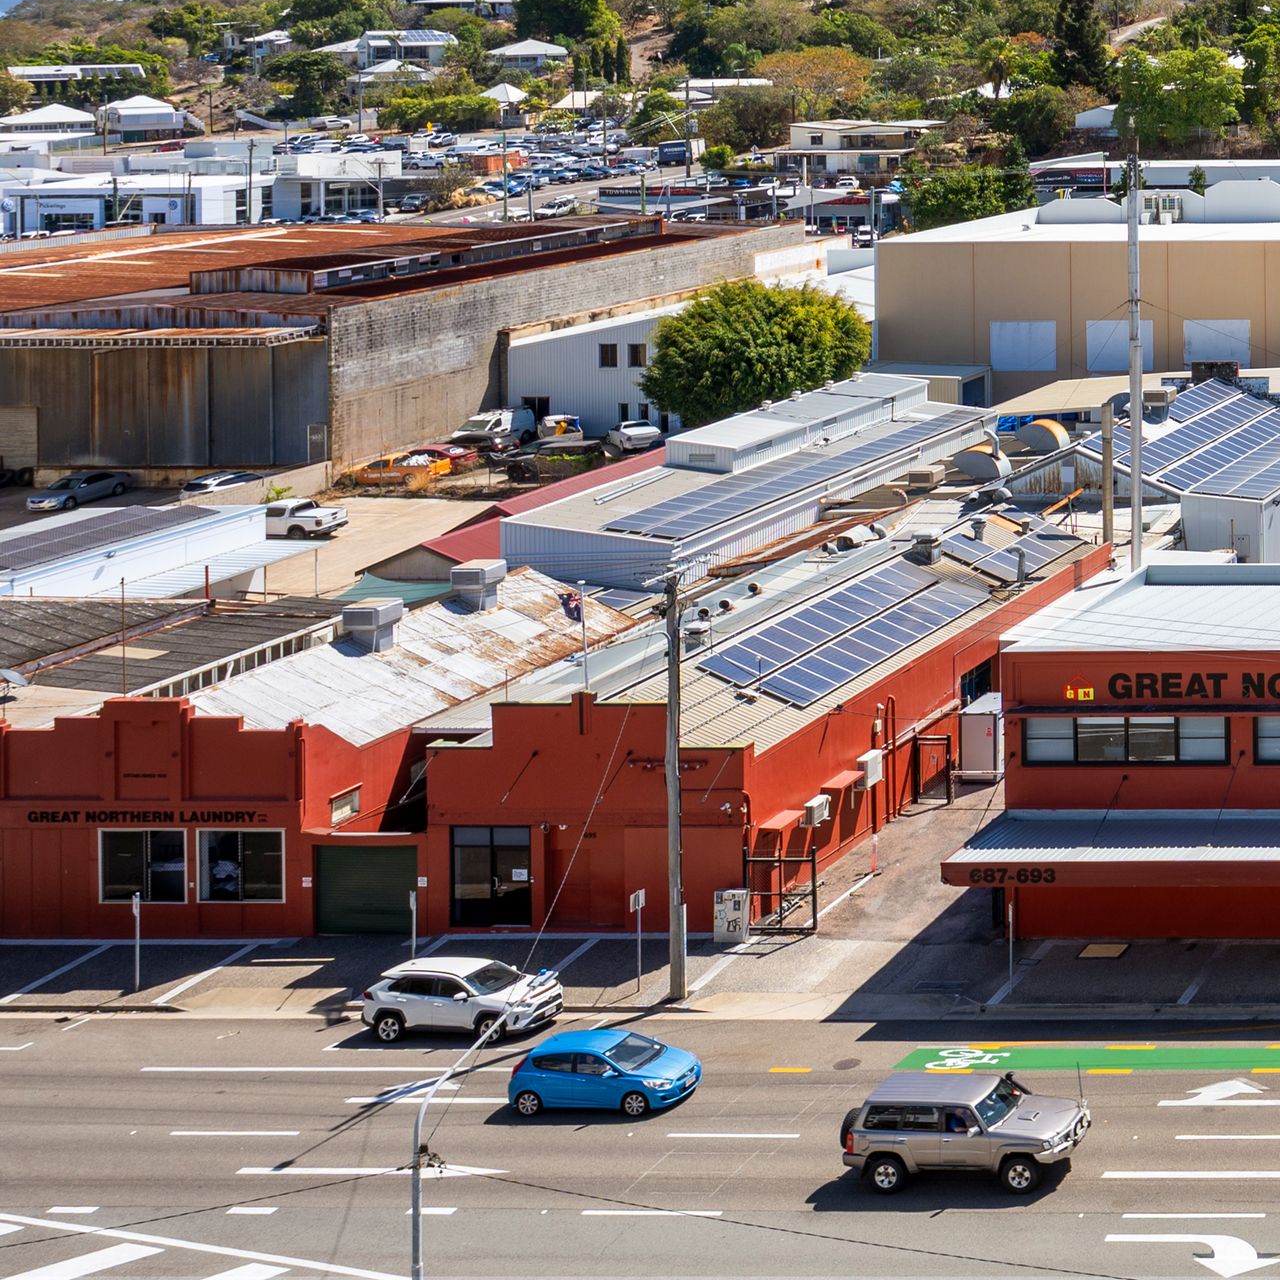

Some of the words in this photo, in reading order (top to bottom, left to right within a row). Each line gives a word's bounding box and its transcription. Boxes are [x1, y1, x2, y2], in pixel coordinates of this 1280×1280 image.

[1107, 672, 1228, 699] GREAT
[27, 811, 81, 823] GREAT
[86, 811, 174, 823] NORTHERN
[179, 811, 257, 823] LAUNDRY
[969, 868, 1056, 883] 687-693
